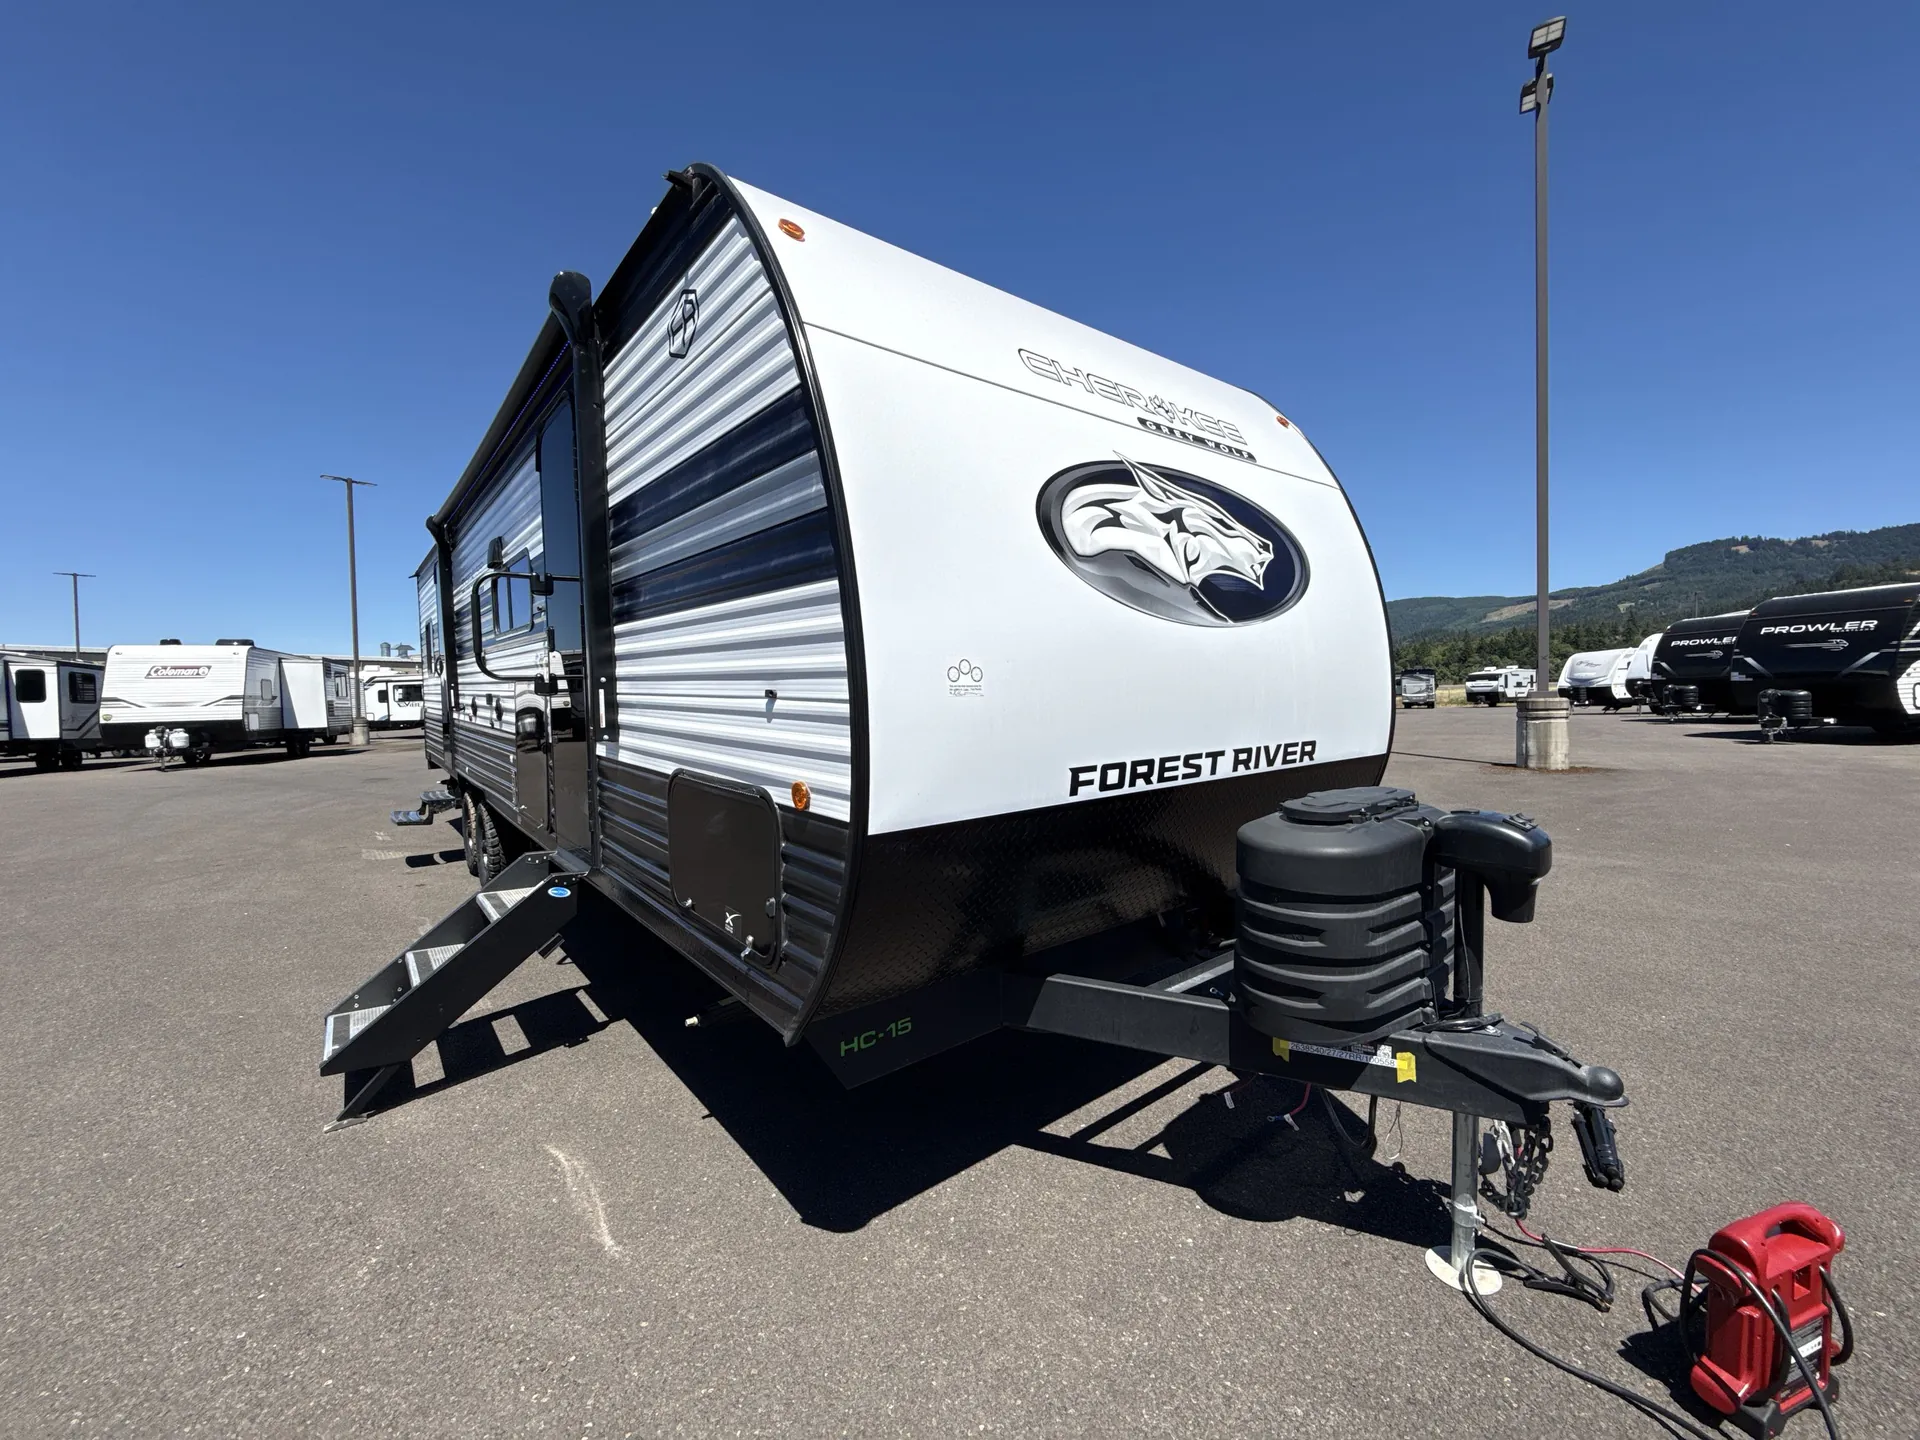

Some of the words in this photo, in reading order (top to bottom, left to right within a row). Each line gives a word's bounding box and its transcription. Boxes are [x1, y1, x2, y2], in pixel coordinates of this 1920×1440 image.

[1145, 420, 1195, 442] GREY
[1204, 439, 1250, 459] WOLF
[1760, 620, 1878, 635] PROWLER
[150, 666, 198, 677] Coleman
[1069, 750, 1226, 797] FOREST
[1232, 740, 1317, 773] RIVER
[840, 1017, 912, 1057] HC-15
